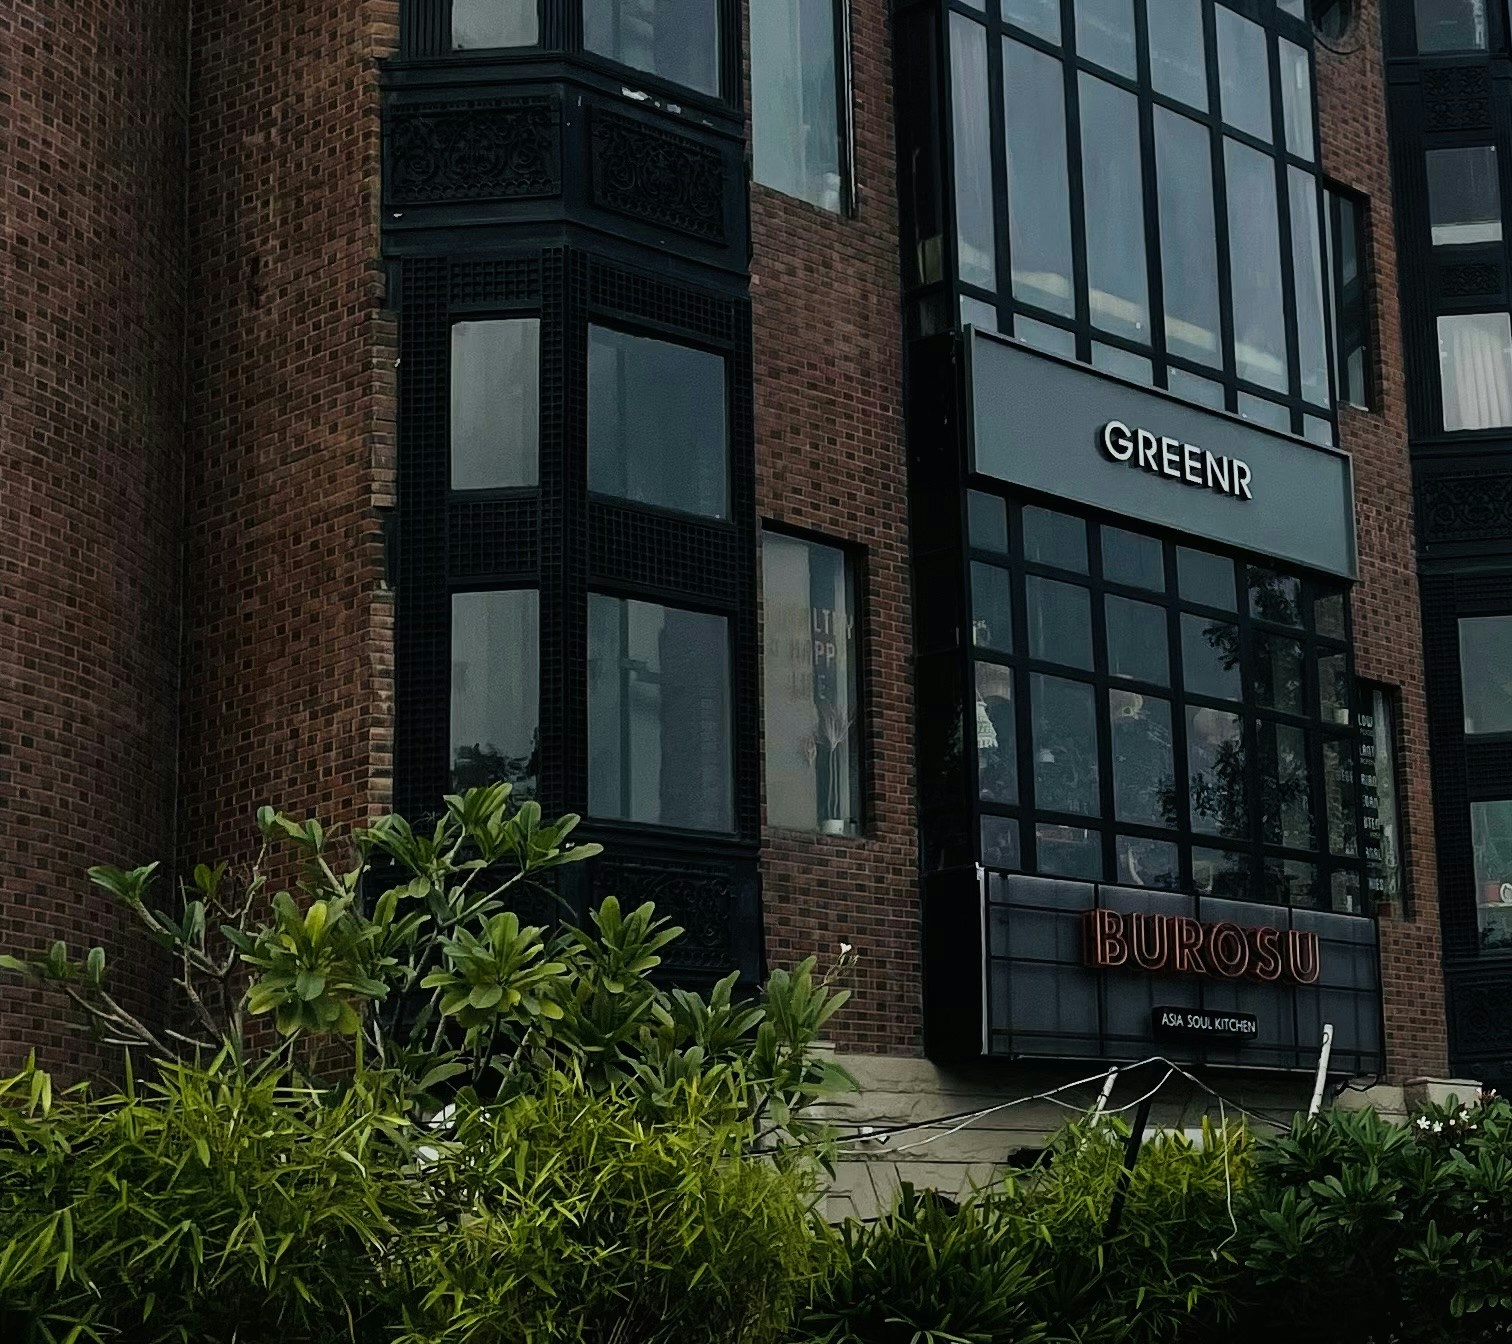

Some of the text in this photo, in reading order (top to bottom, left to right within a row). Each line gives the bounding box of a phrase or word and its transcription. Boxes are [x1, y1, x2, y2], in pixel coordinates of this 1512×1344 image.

[1104, 420, 1254, 500] GREENR
[1094, 908, 1320, 984] BUROSU
[1161, 1013, 1256, 1033] ASIA SOUL KITCHEN
